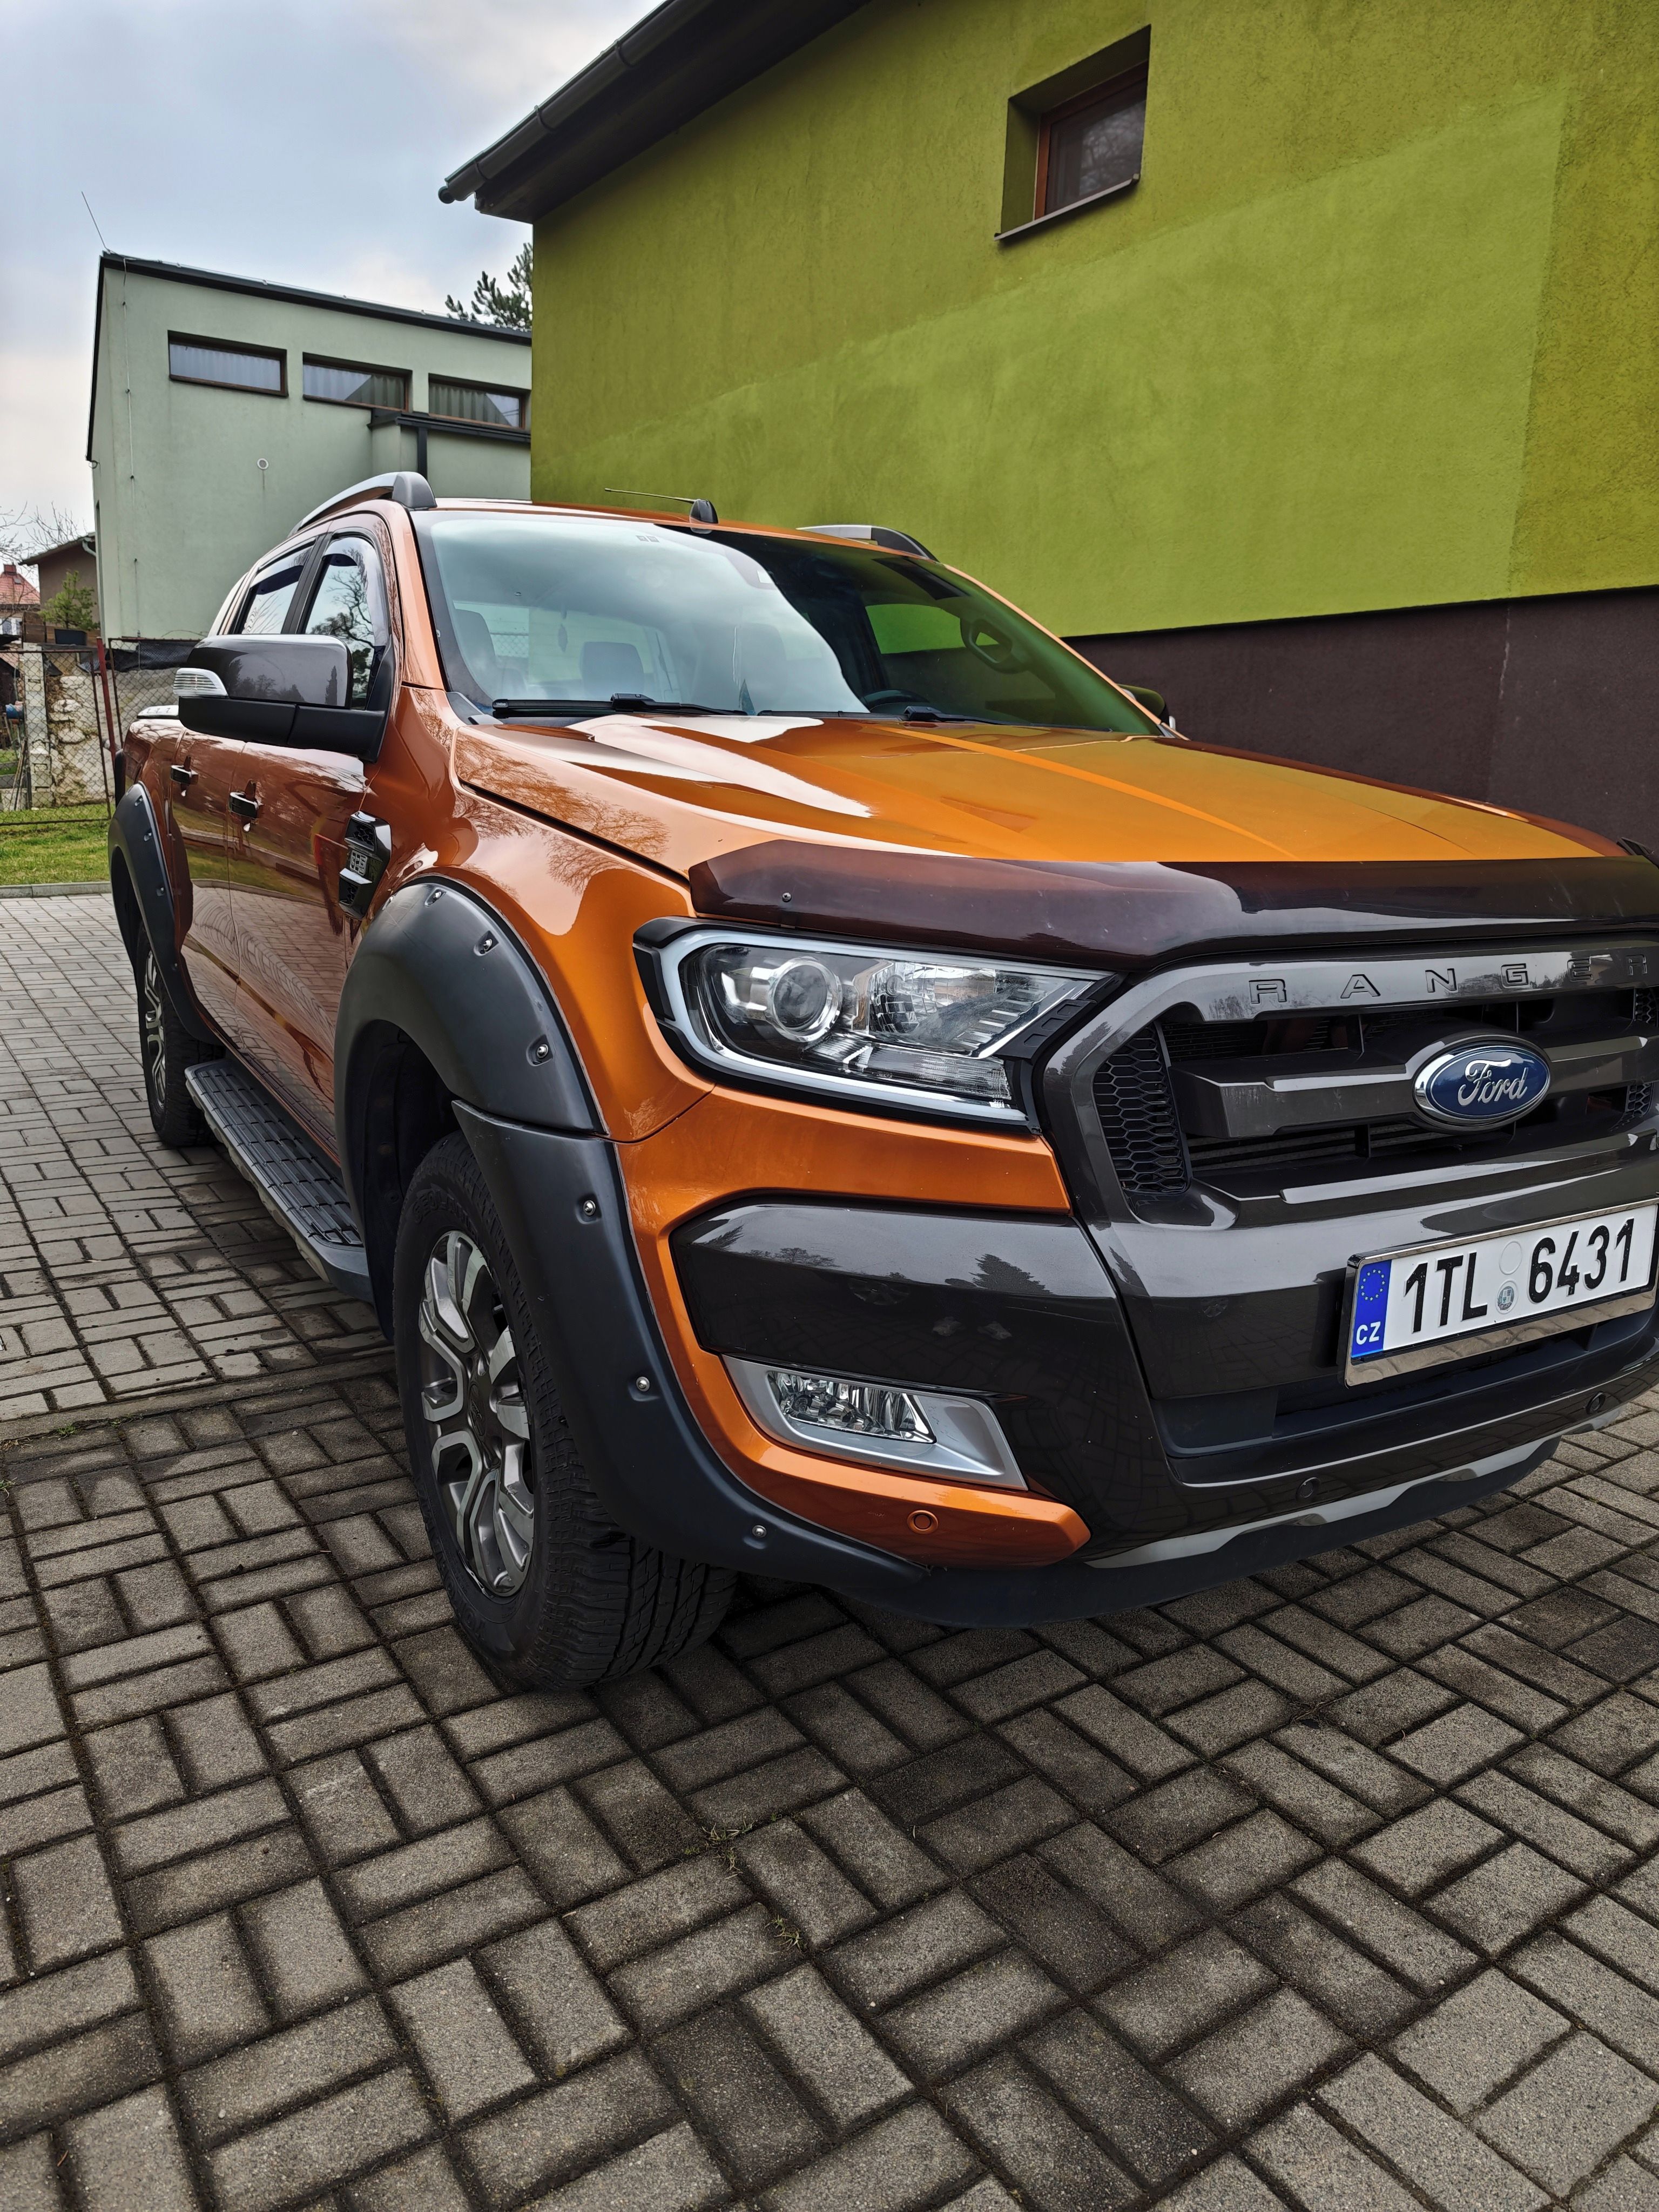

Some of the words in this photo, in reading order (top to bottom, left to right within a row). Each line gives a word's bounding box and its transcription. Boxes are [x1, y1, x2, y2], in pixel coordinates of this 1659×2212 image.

[1248, 954, 1649, 1004] RANGER
[1458, 1058, 1529, 1106] Ford
[1405, 1251, 1488, 1333] 1TL
[1528, 1217, 1635, 1303] 6431
[1356, 1321, 1381, 1345] CZ
